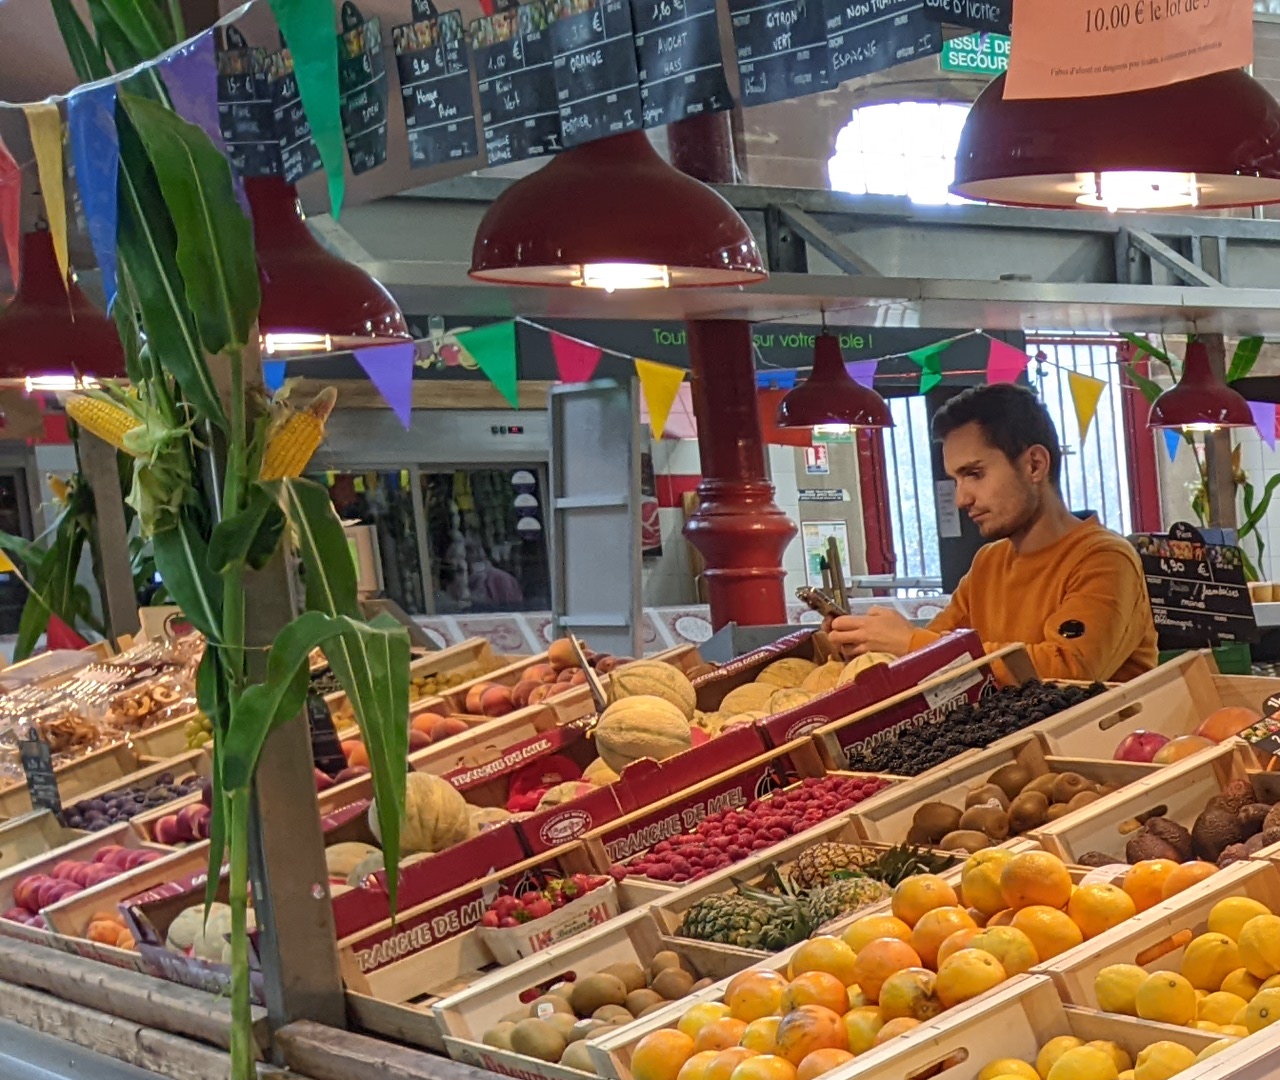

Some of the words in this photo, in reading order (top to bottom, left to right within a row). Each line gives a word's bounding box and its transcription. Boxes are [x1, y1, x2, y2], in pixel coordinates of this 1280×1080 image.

[765, 11, 799, 29] CITRON
[846, 4, 870, 20] NON
[1085, 7, 1131, 34] 10.00
[1134, 0, 1147, 26] €
[1149, 0, 1162, 23] le
[1164, 0, 1182, 18] lot
[656, 32, 689, 55] AVOCAT
[772, 32, 793, 51] VERT
[950, 36, 992, 54] ISSUE
[832, 40, 877, 71] ESPAGNE
[949, 51, 1010, 70] SECOUR
[653, 327, 687, 345] Tout
[753, 332, 774, 348] sur
[781, 331, 816, 348] votre
[838, 333, 865, 349] ble
[1197, 562, 1210, 577] €
[450, 758, 505, 788] TRANCHE
[504, 753, 523, 768] DE
[522, 738, 553, 757] MIEL
[604, 815, 683, 862] TRANCHE
[682, 805, 707, 835] DE
[707, 786, 748, 816] MIEL
[433, 911, 462, 936] DE
[462, 899, 486, 924] MI
